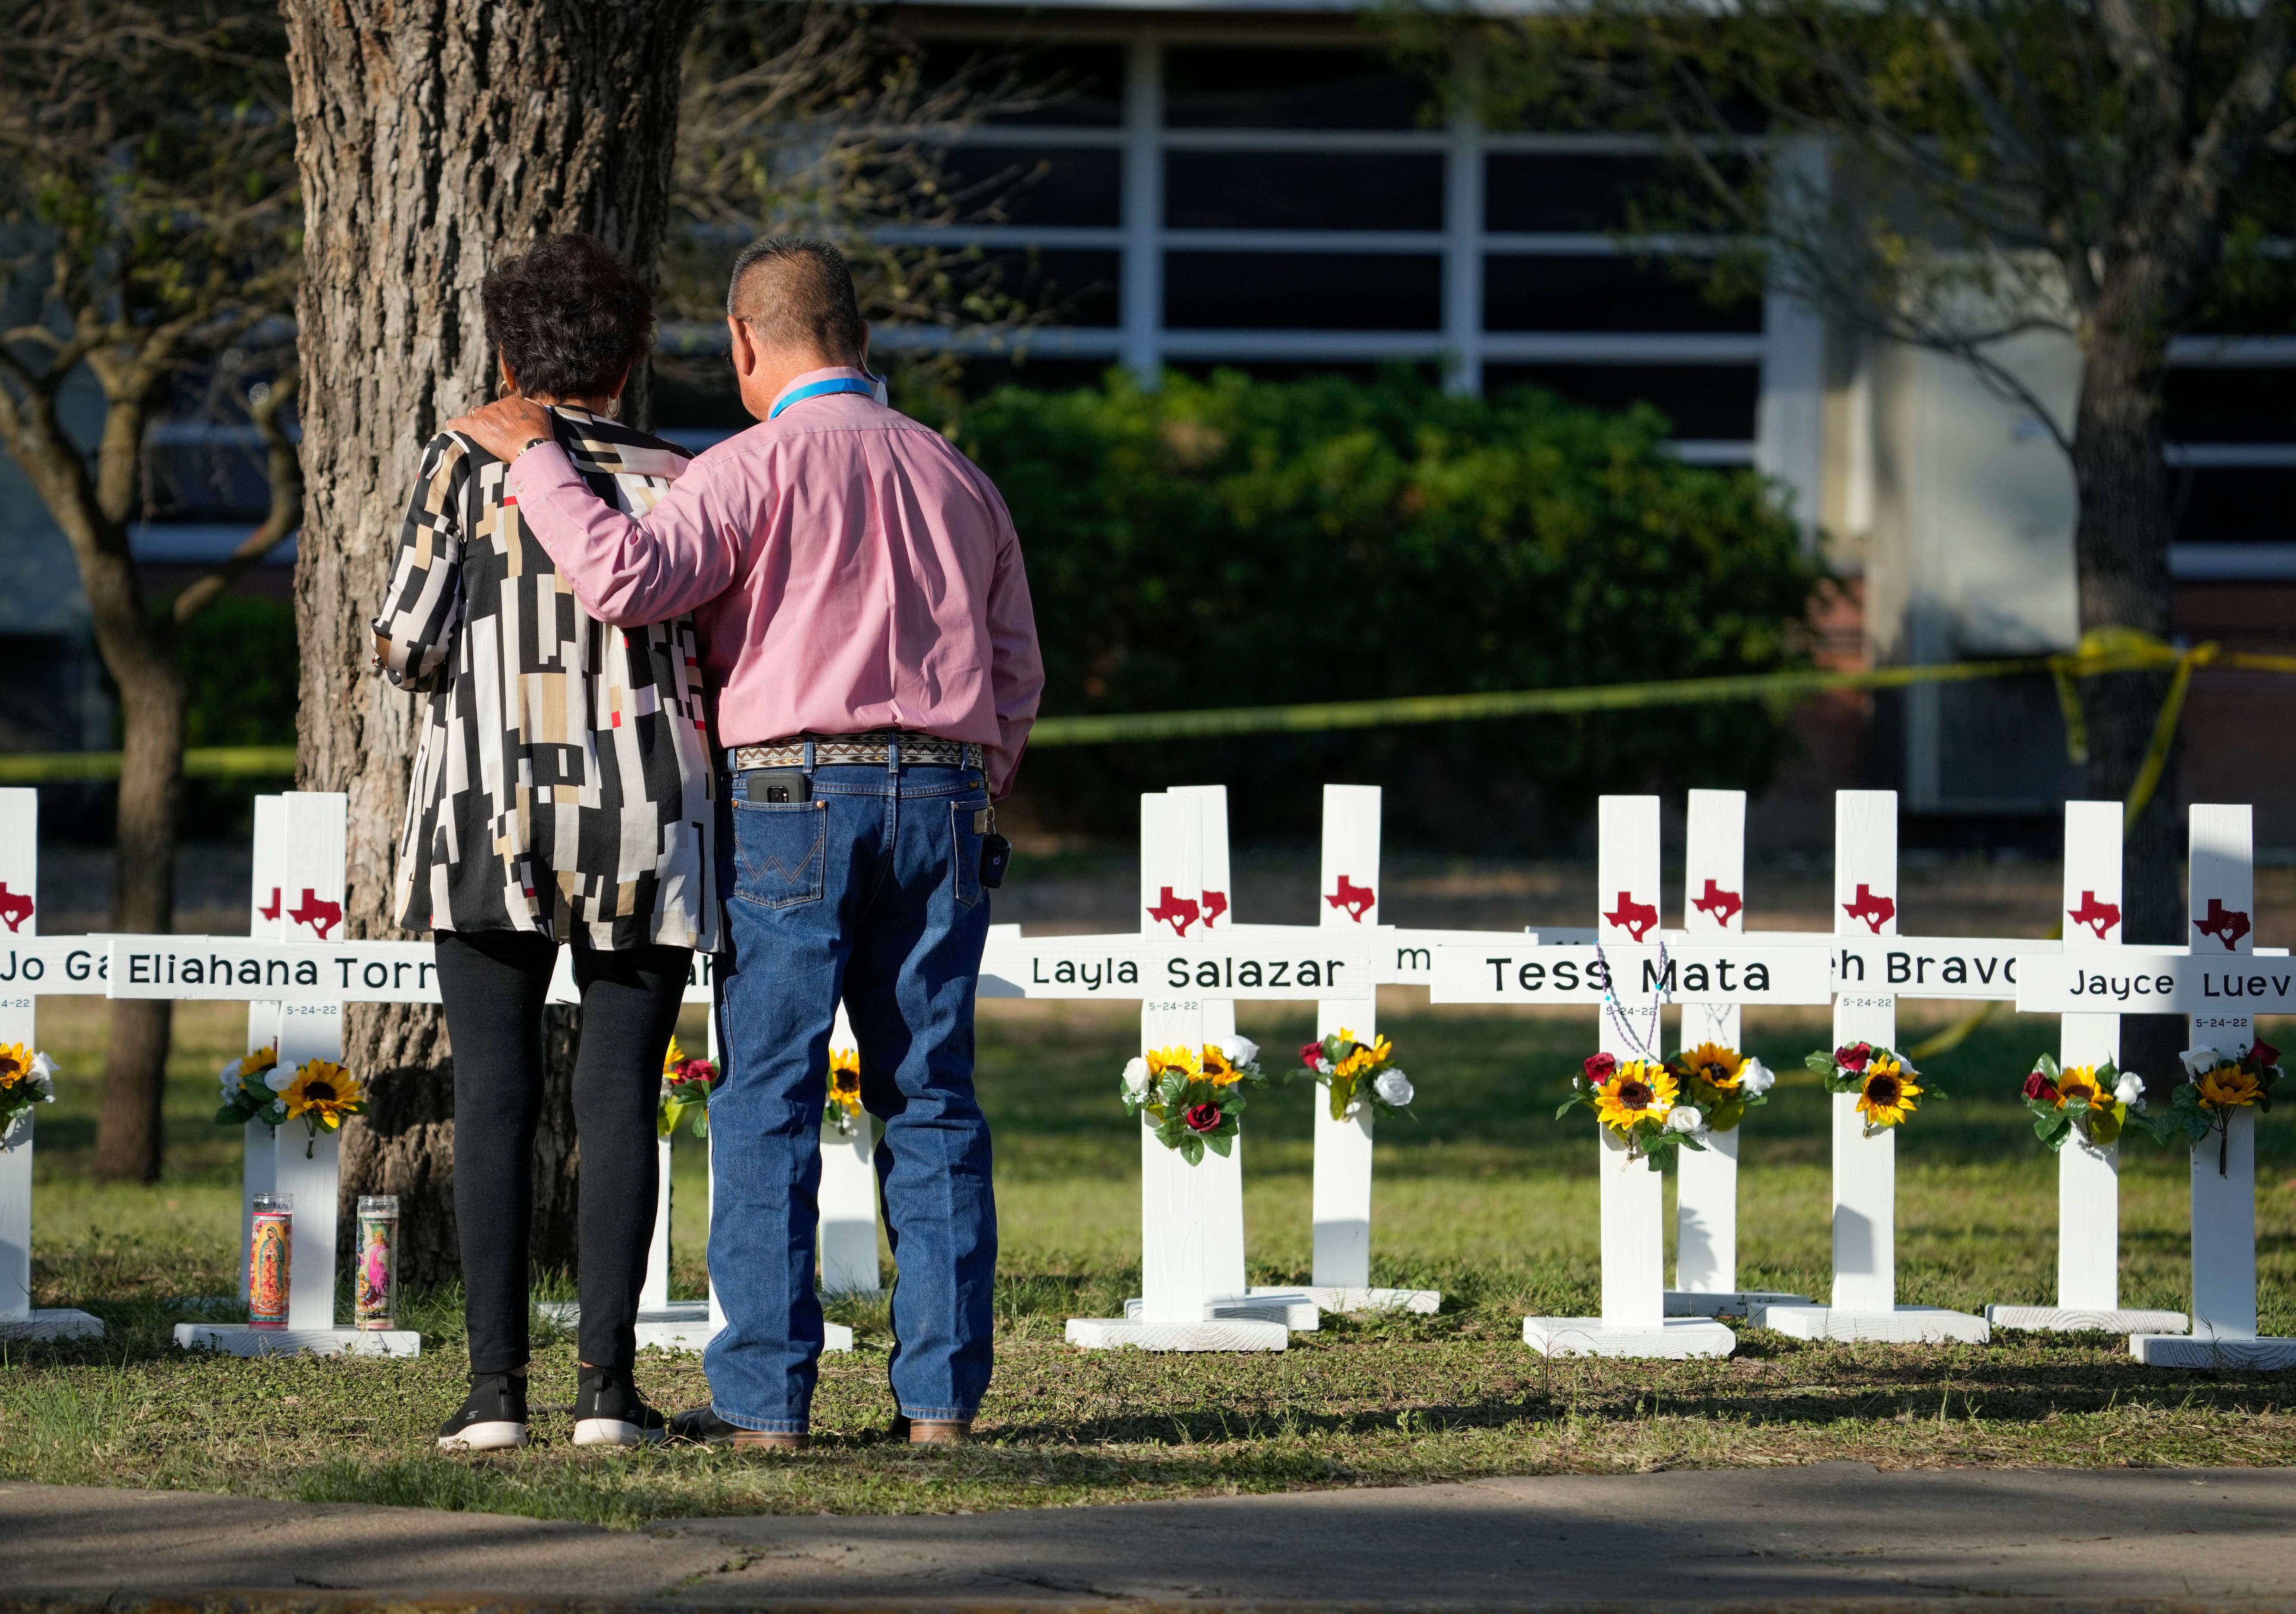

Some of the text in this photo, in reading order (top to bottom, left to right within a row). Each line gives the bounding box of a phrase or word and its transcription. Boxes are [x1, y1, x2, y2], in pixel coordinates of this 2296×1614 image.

[0, 950, 44, 981] Jo
[129, 954, 436, 989] Eliahana Torr
[1033, 957, 1345, 991] Layla Salazar
[1486, 957, 1770, 993] Tess Mata
[1831, 949, 1864, 981] h
[2069, 969, 2296, 1001] Jayce Luev
[287, 1006, 337, 1014] 5-24-22
[1150, 1002, 1198, 1010] 5-24-22
[1606, 1007, 1656, 1016] 5-24-22
[1843, 998, 1891, 1007] 5-24-22
[2196, 1018, 2248, 1028] 5-24-22
